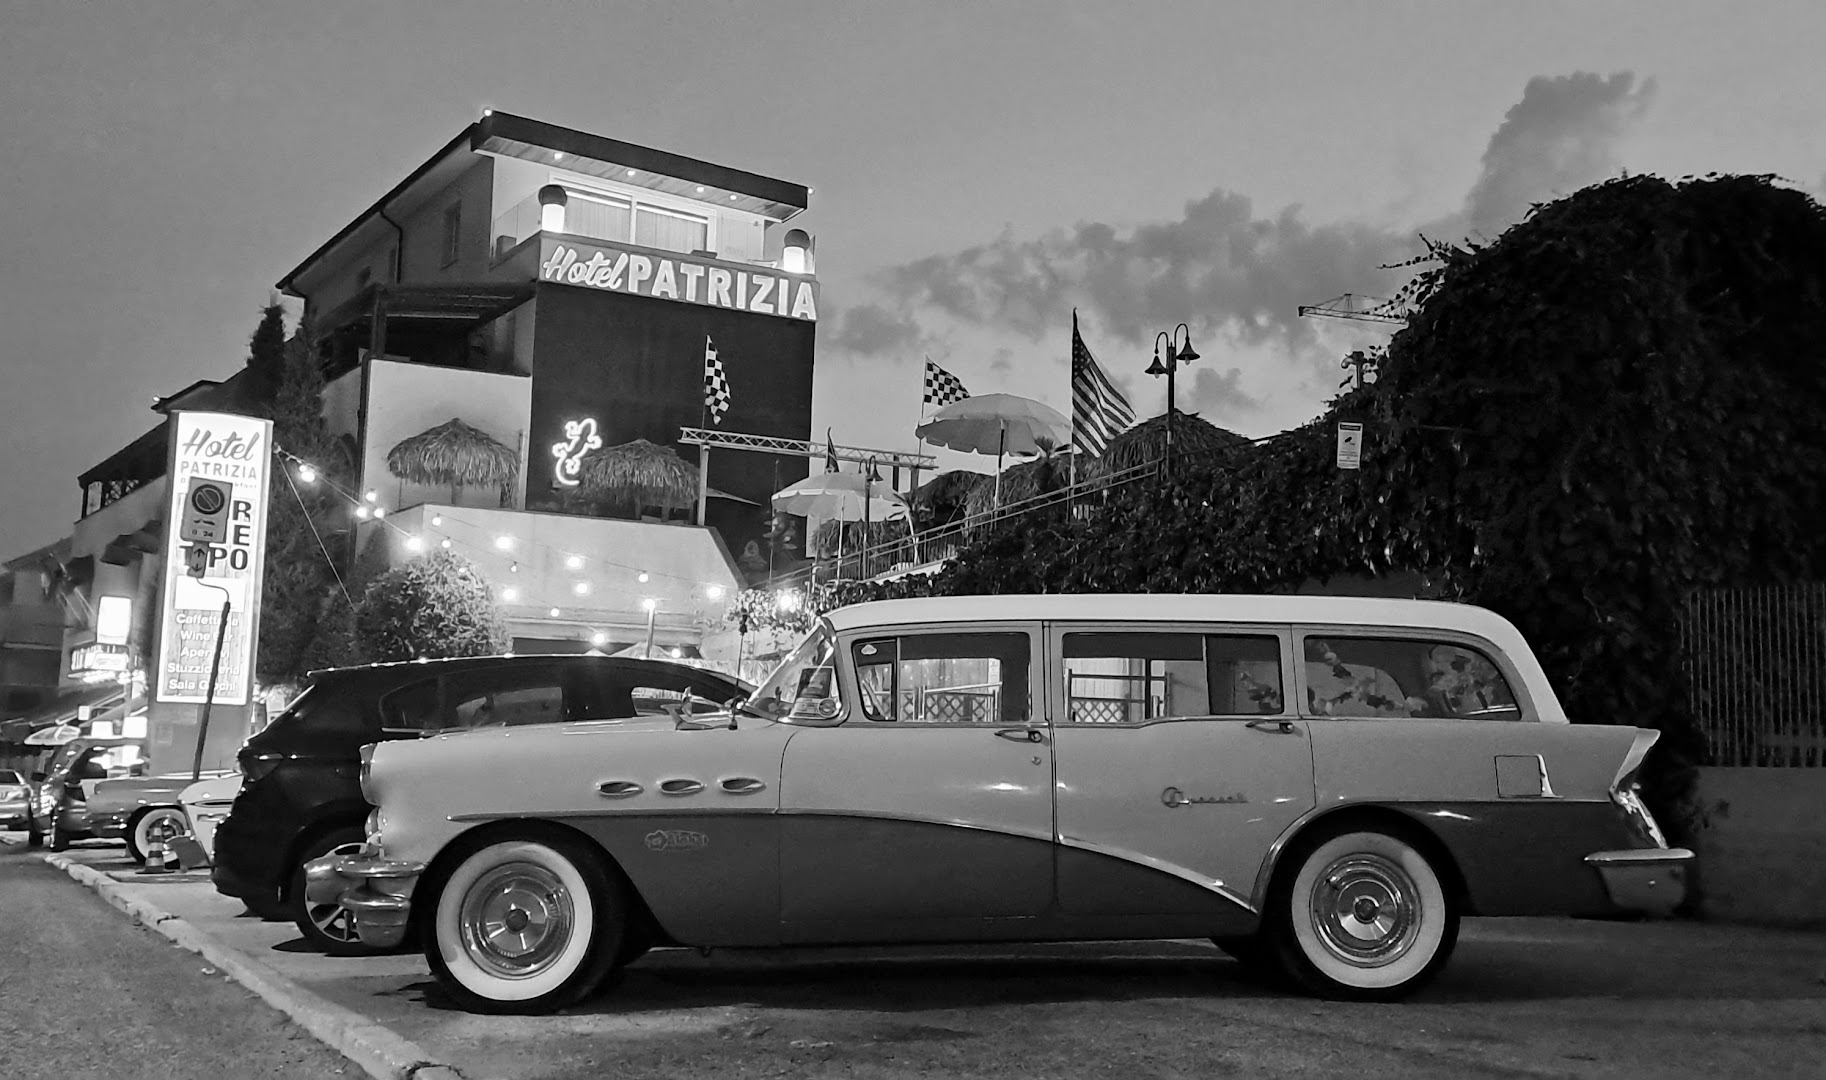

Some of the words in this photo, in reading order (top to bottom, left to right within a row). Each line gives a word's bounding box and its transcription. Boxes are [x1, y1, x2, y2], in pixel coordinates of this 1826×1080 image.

[543, 245, 629, 289] Hotel
[627, 254, 817, 320] PATRIZIA
[182, 428, 260, 461] Hotel
[180, 461, 257, 480] PATRIZIA
[180, 630, 211, 642] Wine
[167, 662, 240, 676] Stuzziceria
[168, 678, 196, 690] Sala
